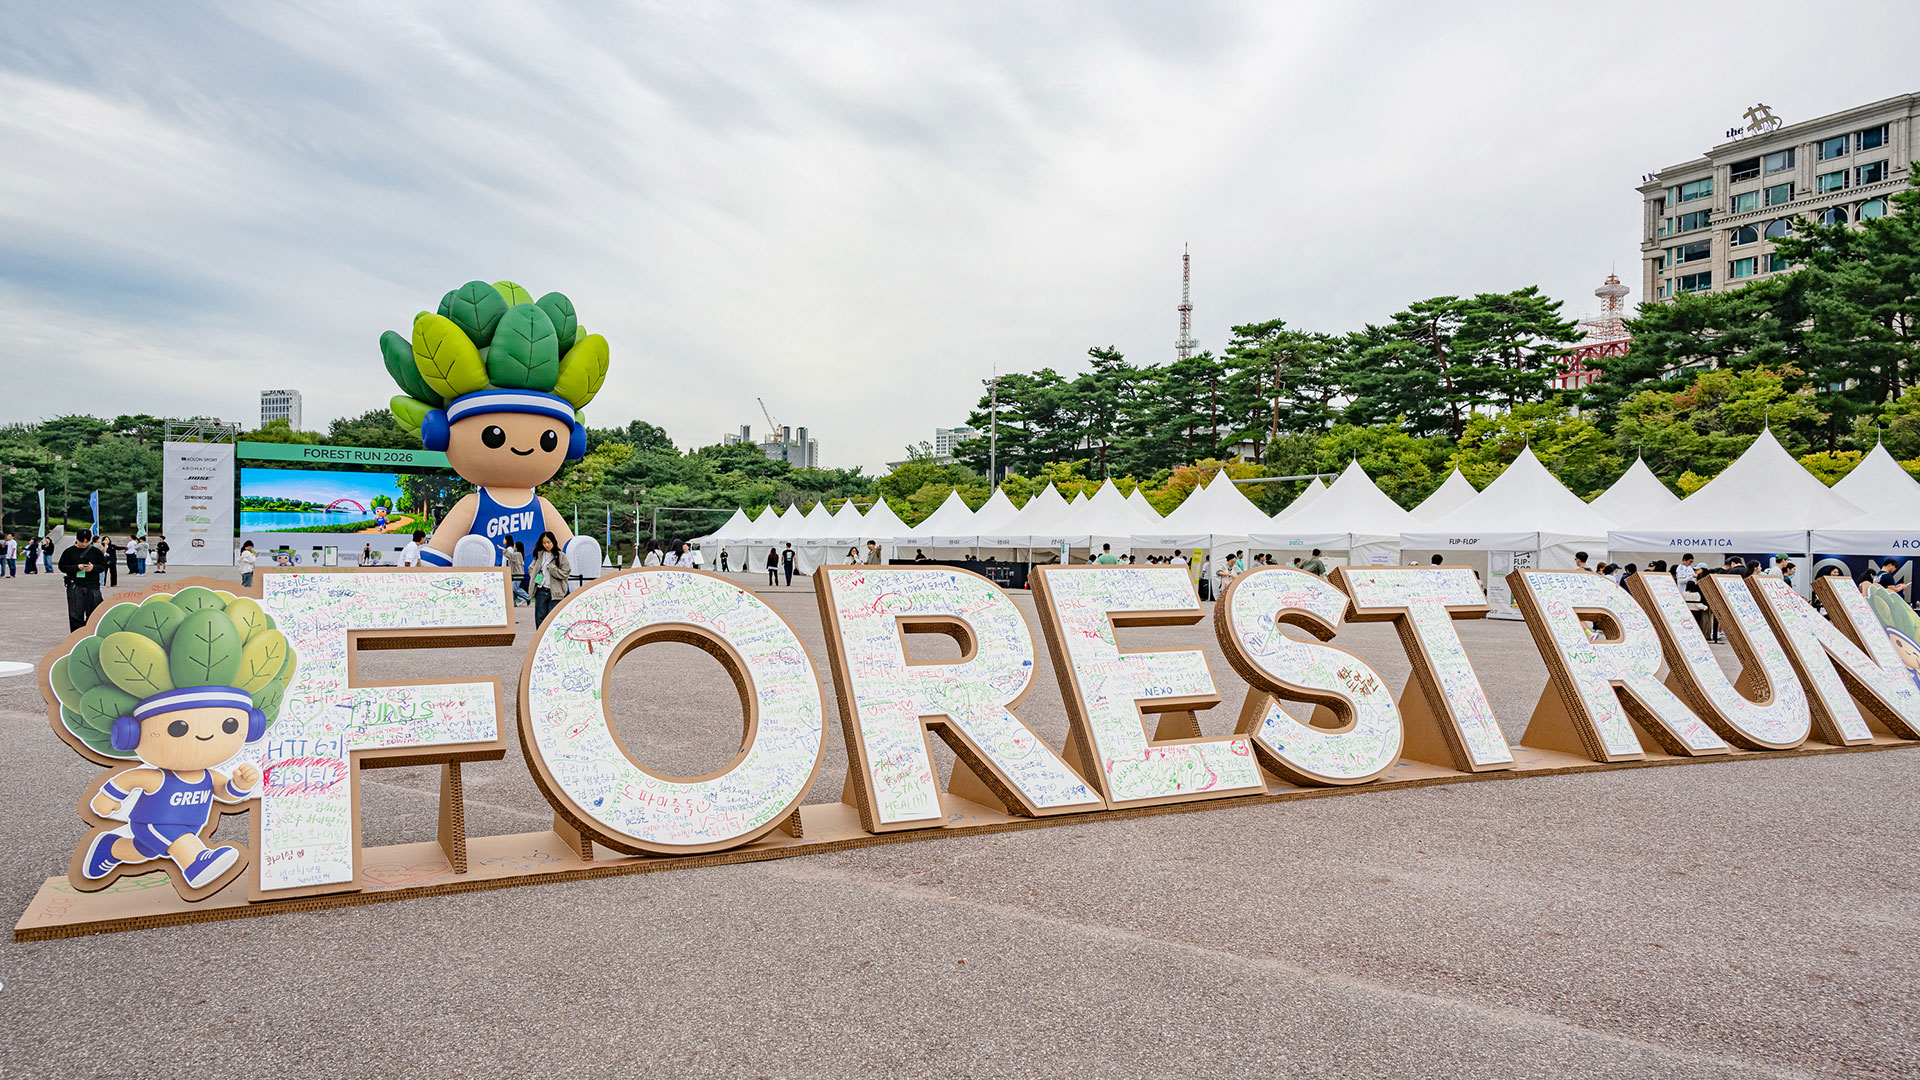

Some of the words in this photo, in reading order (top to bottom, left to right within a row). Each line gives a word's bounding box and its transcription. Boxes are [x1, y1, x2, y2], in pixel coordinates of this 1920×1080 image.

[303, 448, 352, 461] FOREST
[354, 450, 381, 462] RUN
[383, 452, 413, 463] 2026
[486, 511, 535, 539] GREW
[1669, 538, 1733, 548] AROMATICA
[617, 576, 652, 596] 산림
[1144, 686, 1173, 697] NEXO
[248, 560, 1517, 903] FOREST
[169, 788, 211, 808] GREW
[891, 779, 921, 799] STAY
